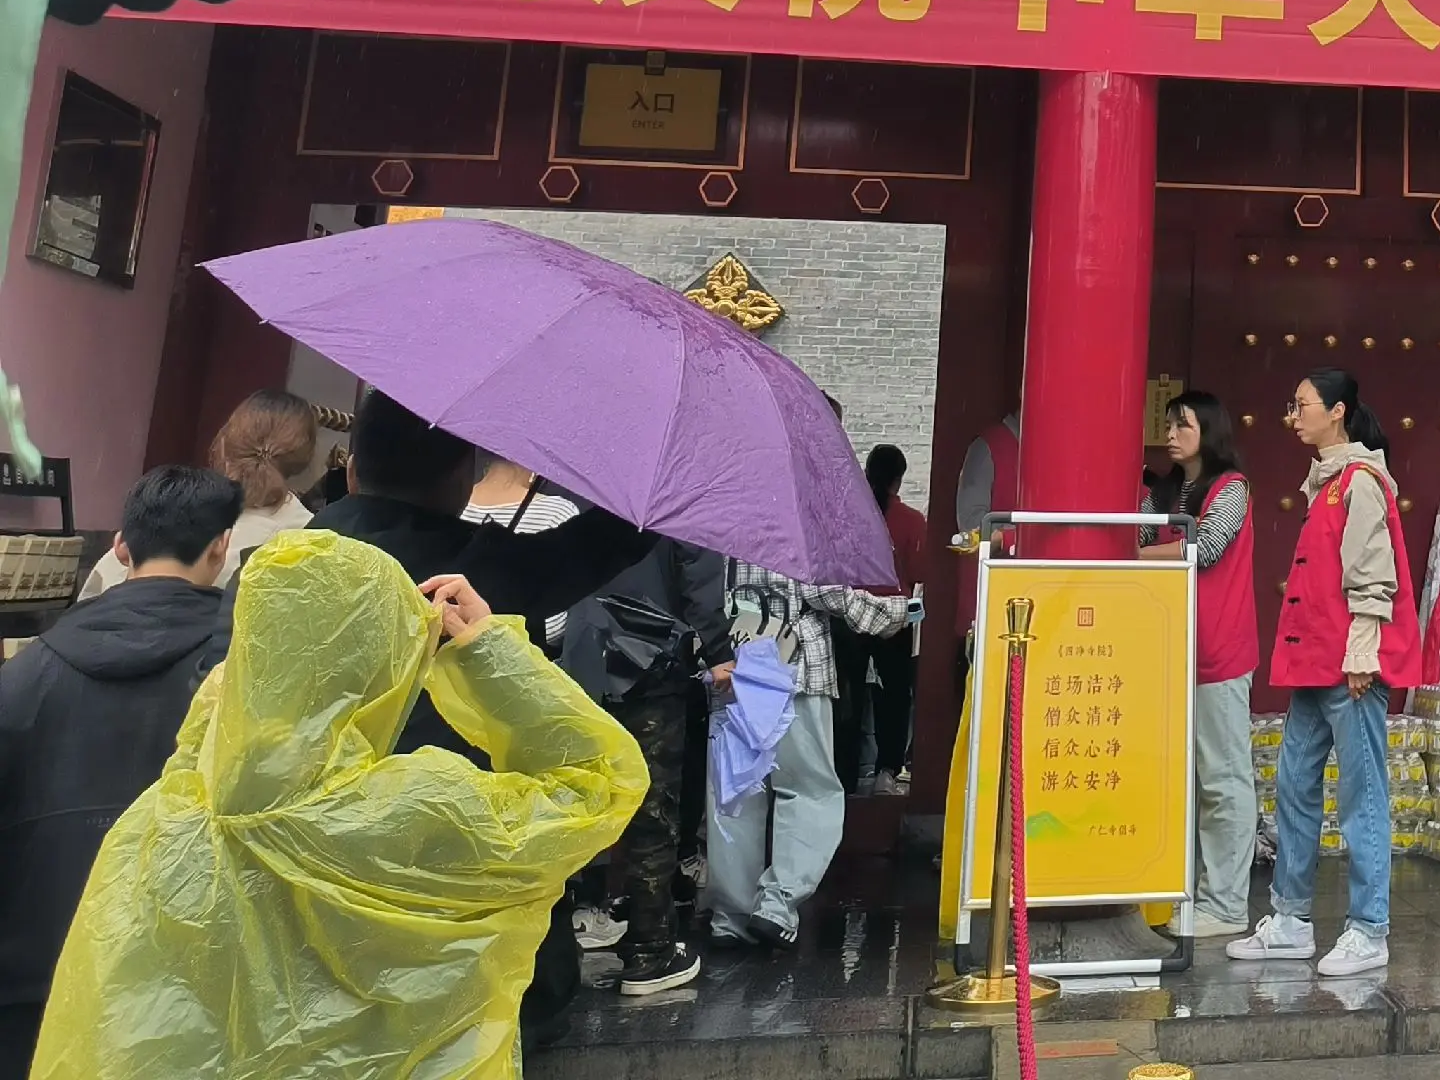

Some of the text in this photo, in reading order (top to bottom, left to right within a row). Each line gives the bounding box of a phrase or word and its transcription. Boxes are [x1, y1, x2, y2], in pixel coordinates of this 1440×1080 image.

[629, 91, 675, 113] 入口
[632, 120, 665, 130] ENTER
[1045, 674, 1124, 695] 道场洁净
[1044, 705, 1123, 727] 僧众清净
[1042, 737, 1122, 759] 信众心净
[1041, 769, 1121, 791] 游众安净
